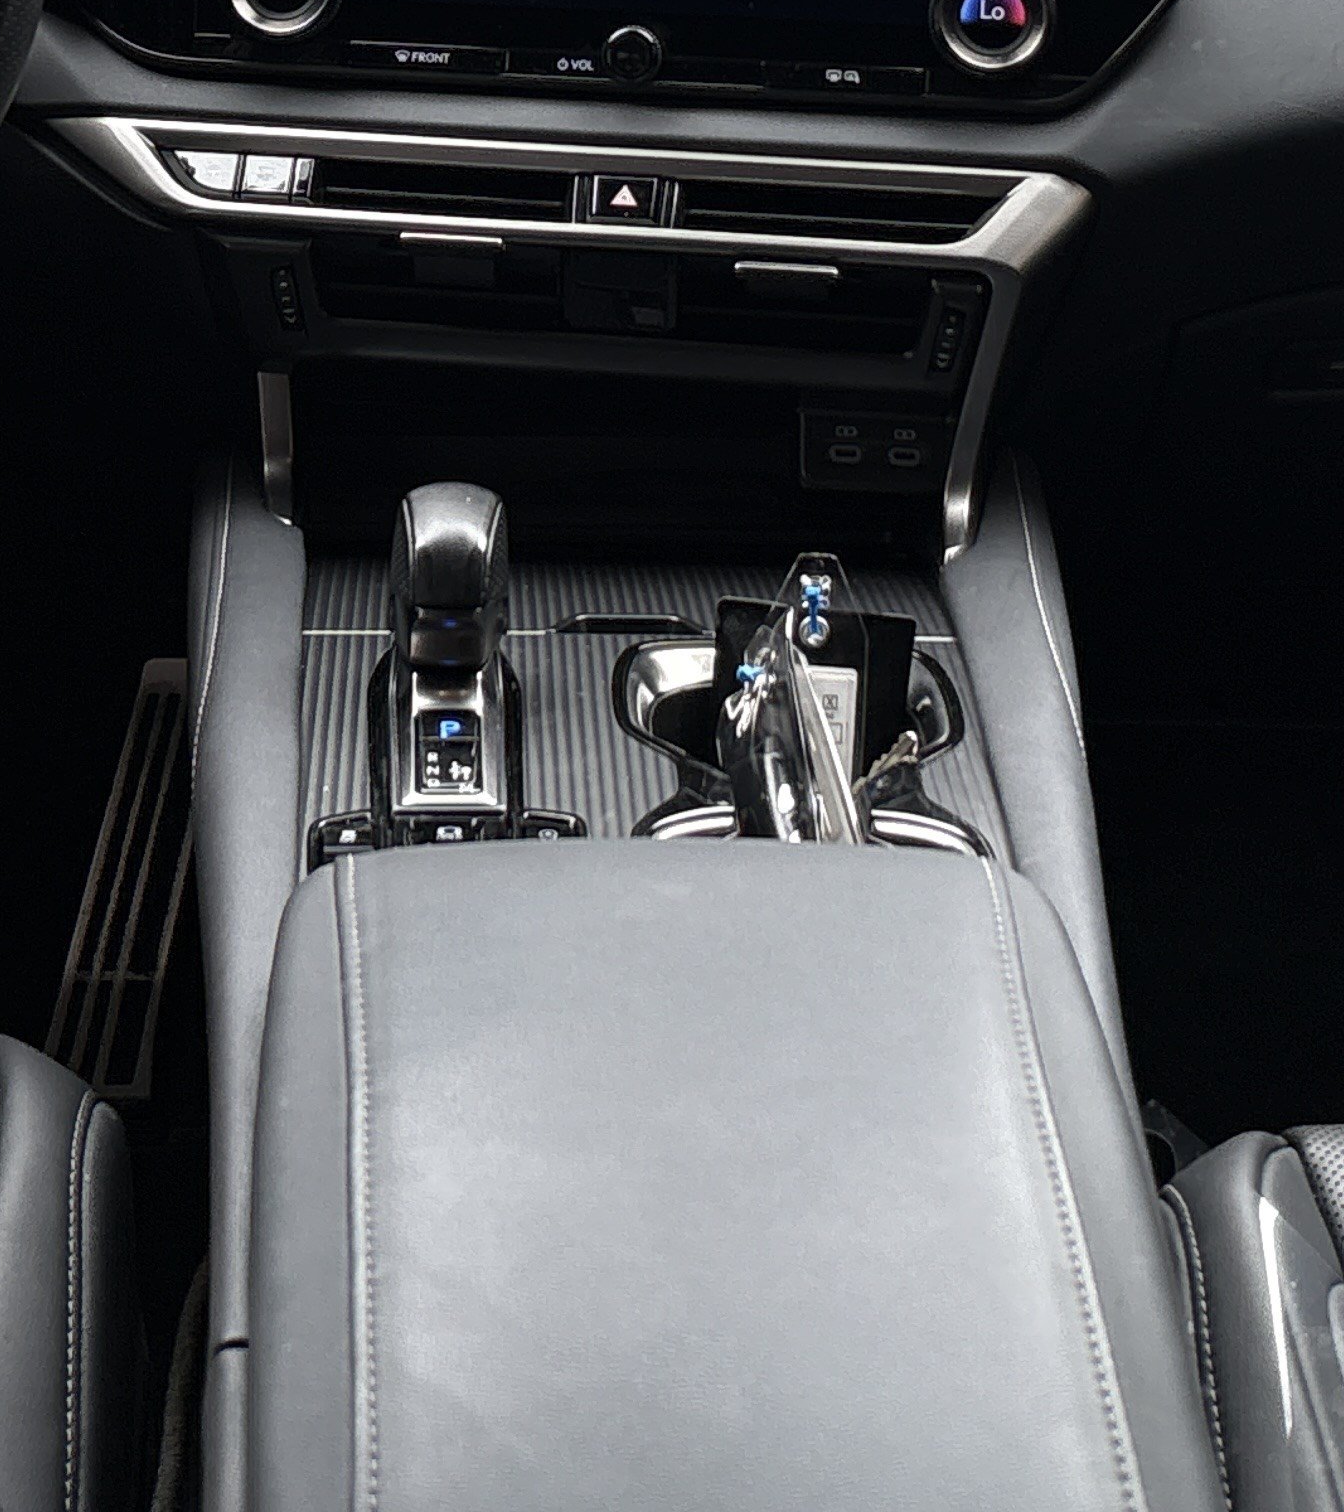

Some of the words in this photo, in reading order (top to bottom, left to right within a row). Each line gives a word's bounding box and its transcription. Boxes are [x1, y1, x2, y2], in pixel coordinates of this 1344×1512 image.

[979, 0, 1006, 21] Lo
[411, 51, 451, 65] FRONT
[570, 59, 594, 71] VOL
[439, 720, 461, 739] P
